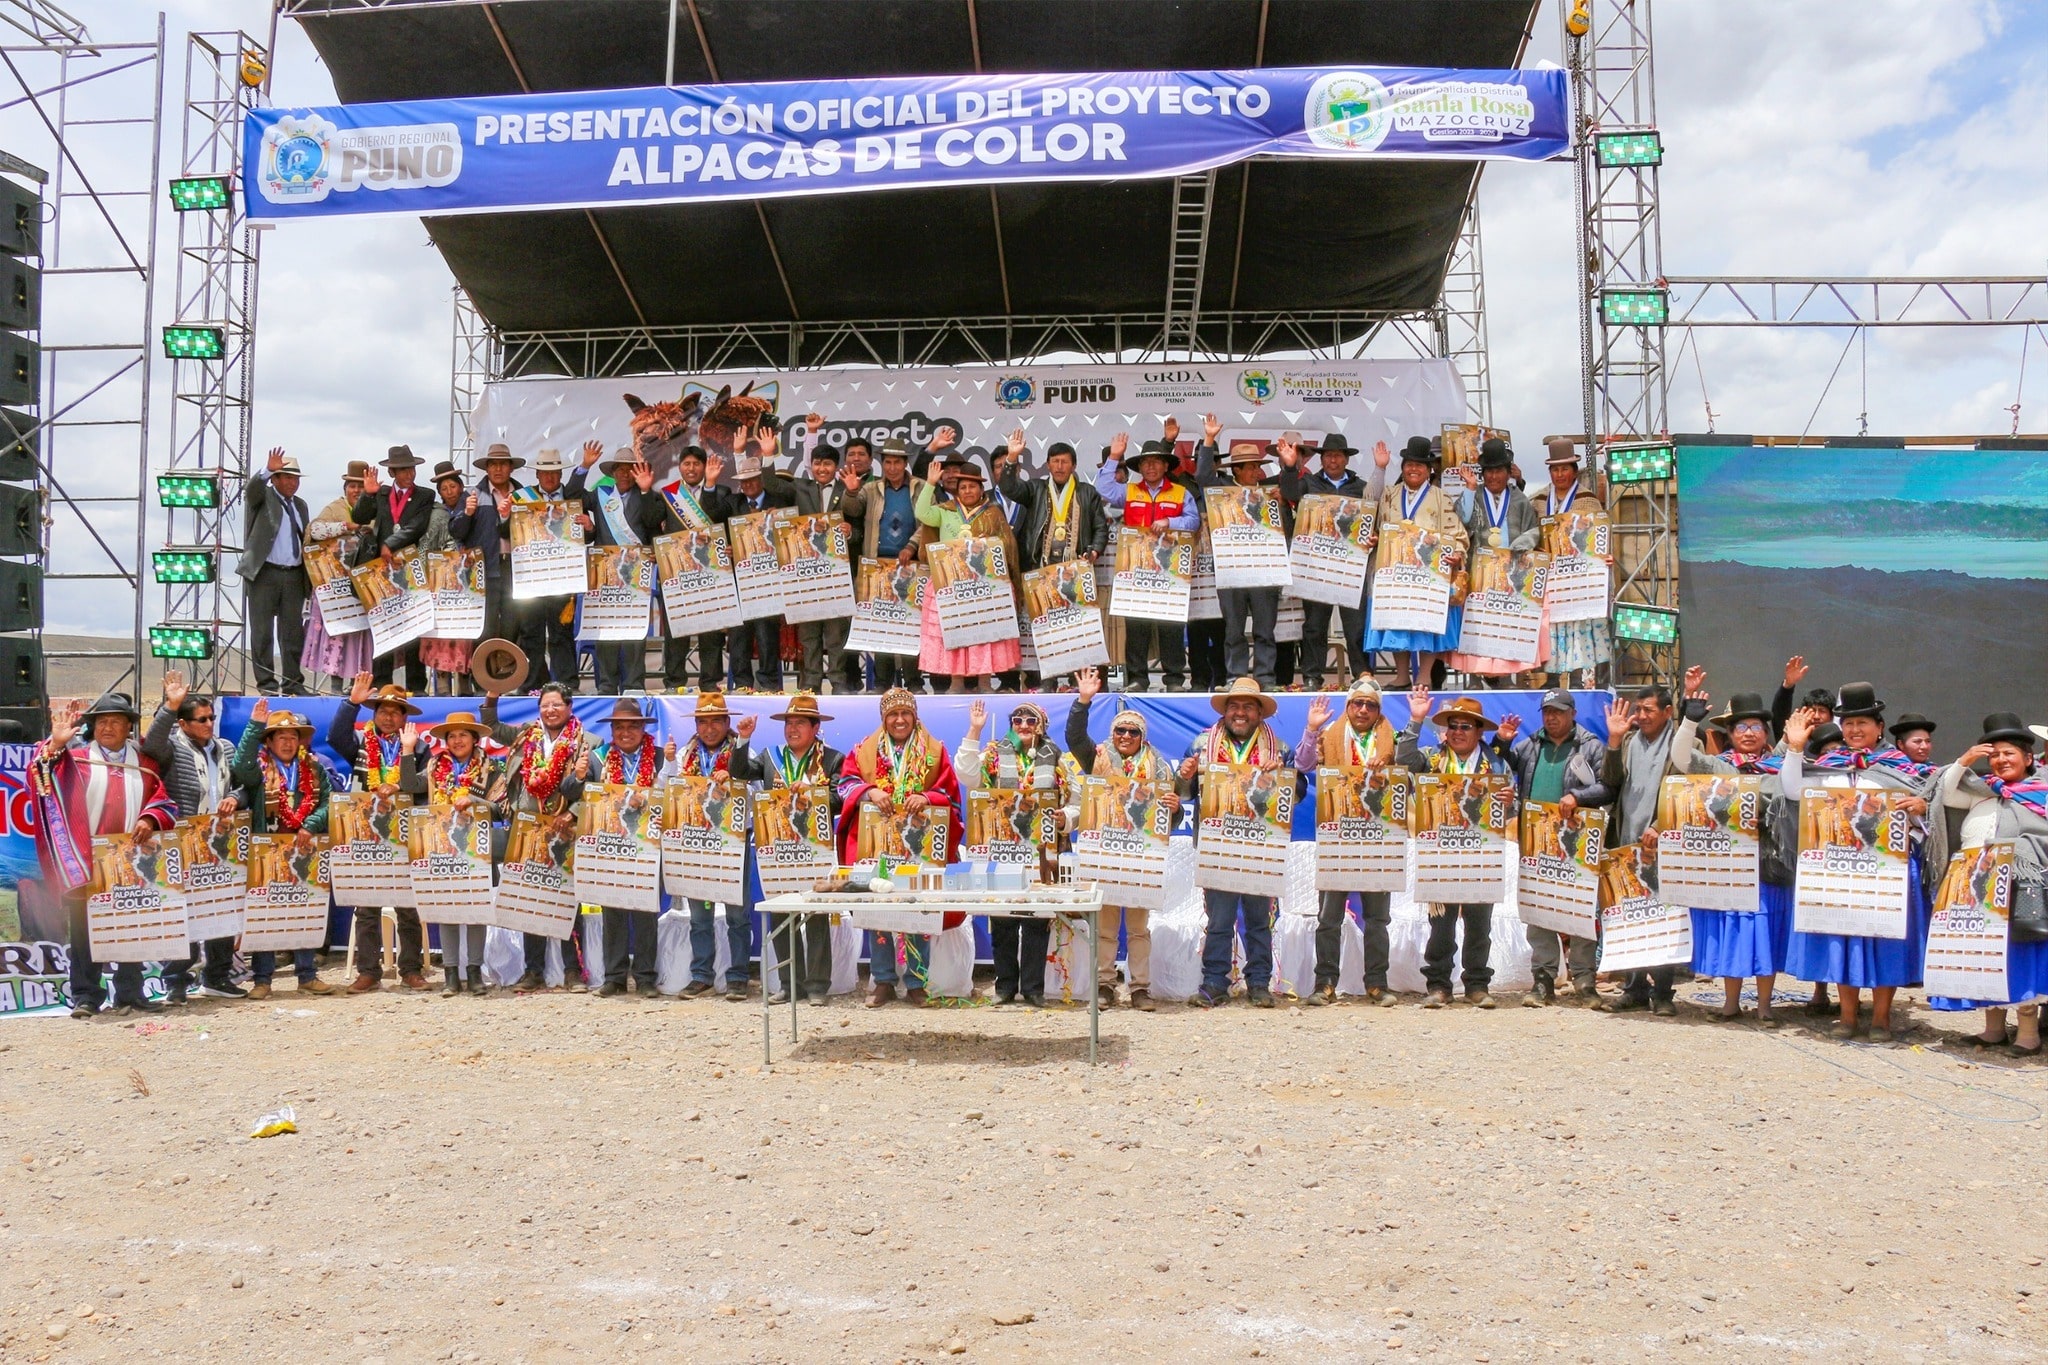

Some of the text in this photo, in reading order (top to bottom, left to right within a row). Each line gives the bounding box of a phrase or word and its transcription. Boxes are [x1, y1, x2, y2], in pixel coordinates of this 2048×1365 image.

[1479, 86, 1522, 96] Distrital
[1472, 95, 1530, 117] Rosa
[475, 84, 1270, 145] PRESENTACIÓN OFICIAL DEL PROYECTO
[1400, 116, 1525, 130] MAZOCRUZ
[341, 132, 452, 148] GOBIERNO REGIONAL
[607, 123, 1127, 187] ALPACAS DE COLOR
[341, 144, 454, 183] PUNO
[1043, 379, 1078, 387] GOBIERNO
[1327, 378, 1362, 388] Rosa
[1044, 385, 1116, 404] PUNO
[1286, 389, 1360, 397] MAZOCRUZ
[1269, 500, 1281, 526] 2026
[1231, 534, 1266, 542] COLOR
[1595, 525, 1607, 554] 2026
[715, 538, 729, 566] 2026
[1313, 545, 1347, 558] COLOR
[992, 547, 1005, 575] 2026
[1179, 545, 1191, 574] 2026
[753, 561, 779, 572] COLO
[799, 566, 831, 577] COLOR
[1556, 563, 1587, 574] COLOR
[409, 559, 426, 586] 2026
[640, 560, 651, 587] 2026
[682, 578, 715, 591] COLOR
[1135, 579, 1170, 589] COLOR
[1394, 574, 1431, 585] COLOR
[1532, 567, 1546, 597] 2026
[916, 576, 928, 605] 2026
[1082, 572, 1095, 601] 2026
[601, 594, 632, 602] COLOR
[956, 588, 991, 599] COLOR
[385, 599, 414, 616] COLOR
[439, 598, 470, 607] COLOR
[1486, 601, 1522, 612] COLOR
[872, 610, 907, 620] COLOR
[1050, 614, 1081, 628] COLOR
[1277, 787, 1292, 823] 2026
[1392, 784, 1405, 819] 2026
[732, 798, 744, 832] 2026
[816, 805, 830, 840] 2026
[1225, 820, 1260, 829] ALPACAS
[684, 831, 716, 839] ALPACAS
[1224, 828, 1266, 841] COLOR
[1341, 830, 1383, 840] COLOR
[1419, 832, 1437, 840] +33
[1662, 832, 1681, 840] +33
[1684, 831, 1722, 839] ALPACAS
[1889, 810, 1907, 851] 2026
[477, 820, 489, 854] 2026
[579, 837, 596, 845] +33
[599, 837, 631, 845] ALPACAS
[933, 825, 946, 860] 2026
[1103, 833, 1138, 841] ALPACAS
[684, 838, 722, 850] COLOR
[776, 844, 806, 852] ALPACAS
[1102, 841, 1144, 853] COLOR
[1440, 839, 1481, 849] COLOR
[1586, 828, 1600, 865] 2026
[1684, 840, 1731, 850] COLOR
[332, 846, 350, 854] +33
[598, 845, 637, 856] COLOR
[758, 847, 774, 855] +33
[970, 846, 988, 854] +33
[1802, 851, 1824, 860] +33
[1827, 851, 1869, 860] ALPACAS
[353, 852, 393, 861] COLOR
[776, 853, 812, 862] COLOR
[990, 853, 1032, 863] COLOR
[1521, 857, 1537, 866] +33
[166, 848, 180, 884] 2026
[318, 850, 330, 883] 2026
[412, 859, 429, 868] +33
[506, 864, 523, 872] +33
[1539, 859, 1570, 870] ALPACAS
[1826, 861, 1878, 873] COLOR
[192, 866, 225, 875] ALPACAS
[432, 866, 469, 875] COLOR
[525, 865, 557, 876] ALPACAS
[1539, 868, 1576, 882] COLOR
[192, 872, 232, 885] COLOR
[524, 873, 561, 888] COLOR
[1995, 864, 2009, 907] 2026
[114, 890, 152, 899] ALPACAS
[249, 888, 267, 896] +33
[92, 894, 112, 903] +33
[269, 894, 308, 902] COLOR
[115, 900, 160, 910] COLOR
[1604, 907, 1622, 916] +33
[1625, 907, 1666, 921] COLOR
[1934, 911, 1948, 920] +33
[1949, 911, 1979, 919] ALPACAS
[1948, 919, 1984, 932] COLOR
